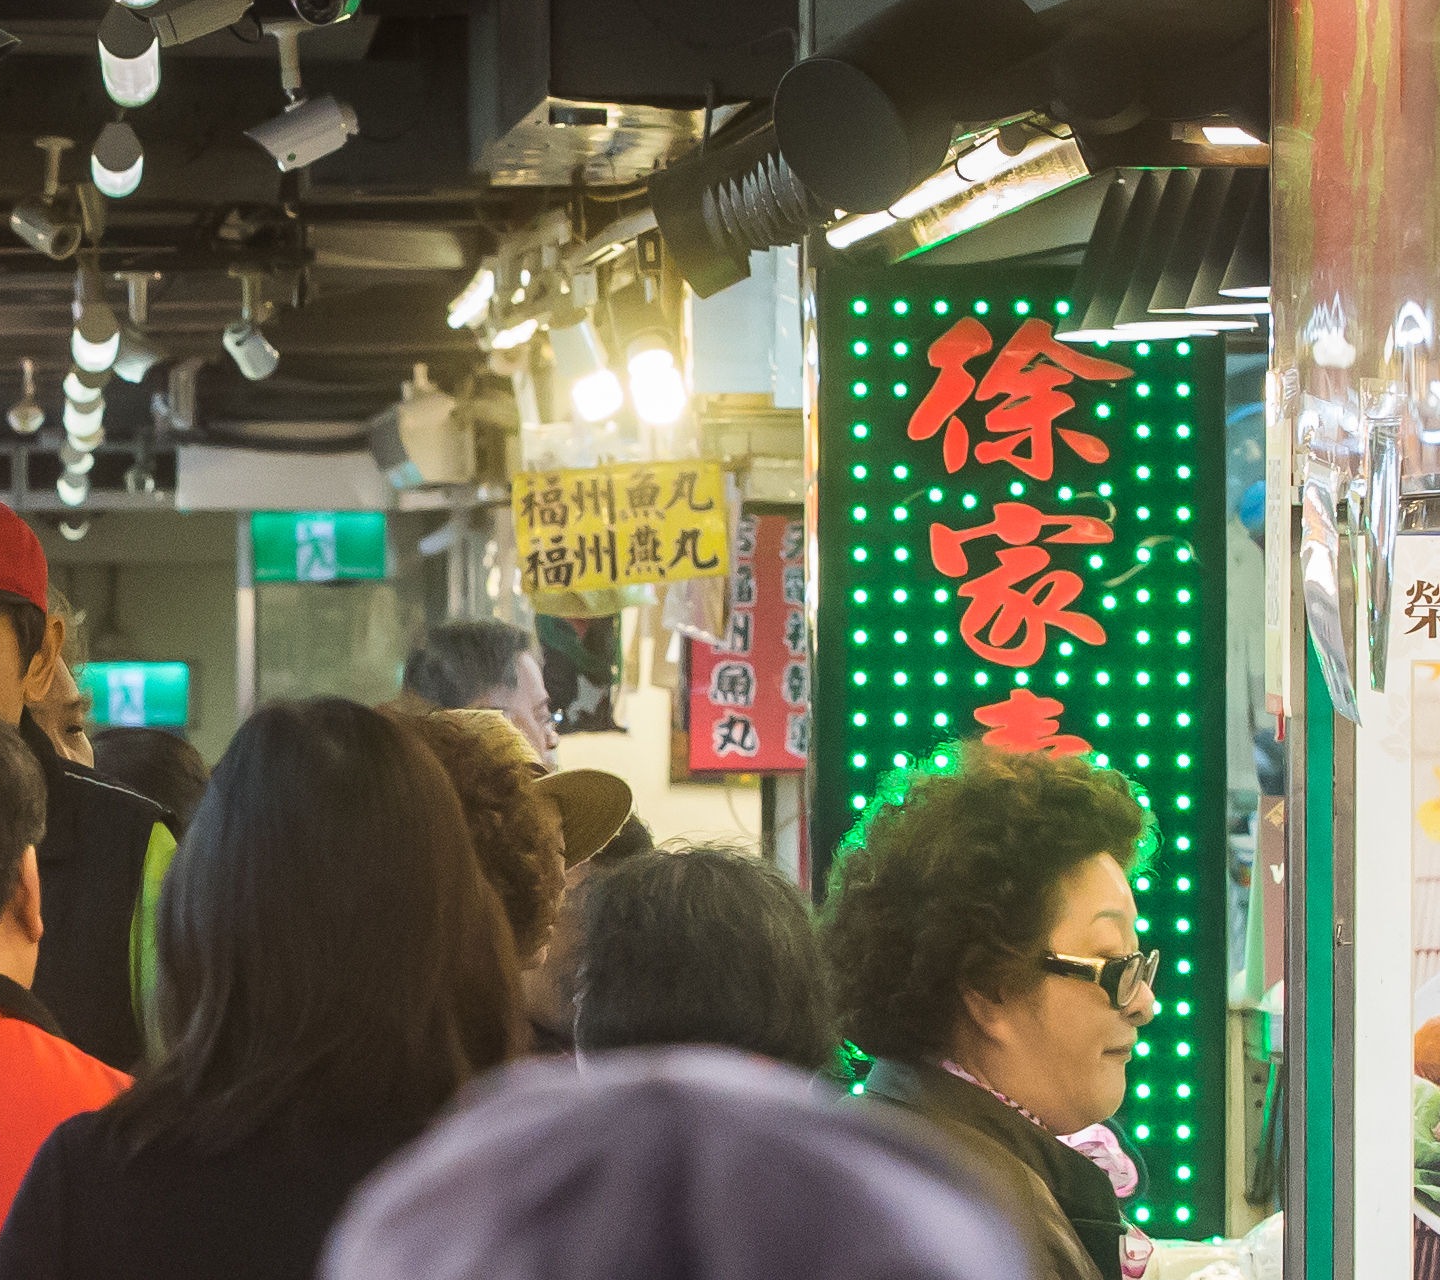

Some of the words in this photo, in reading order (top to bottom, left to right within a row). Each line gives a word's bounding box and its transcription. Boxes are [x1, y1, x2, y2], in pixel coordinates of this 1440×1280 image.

[521, 471, 716, 530] 福州魚丸
[525, 527, 720, 593] 福州燕丸
